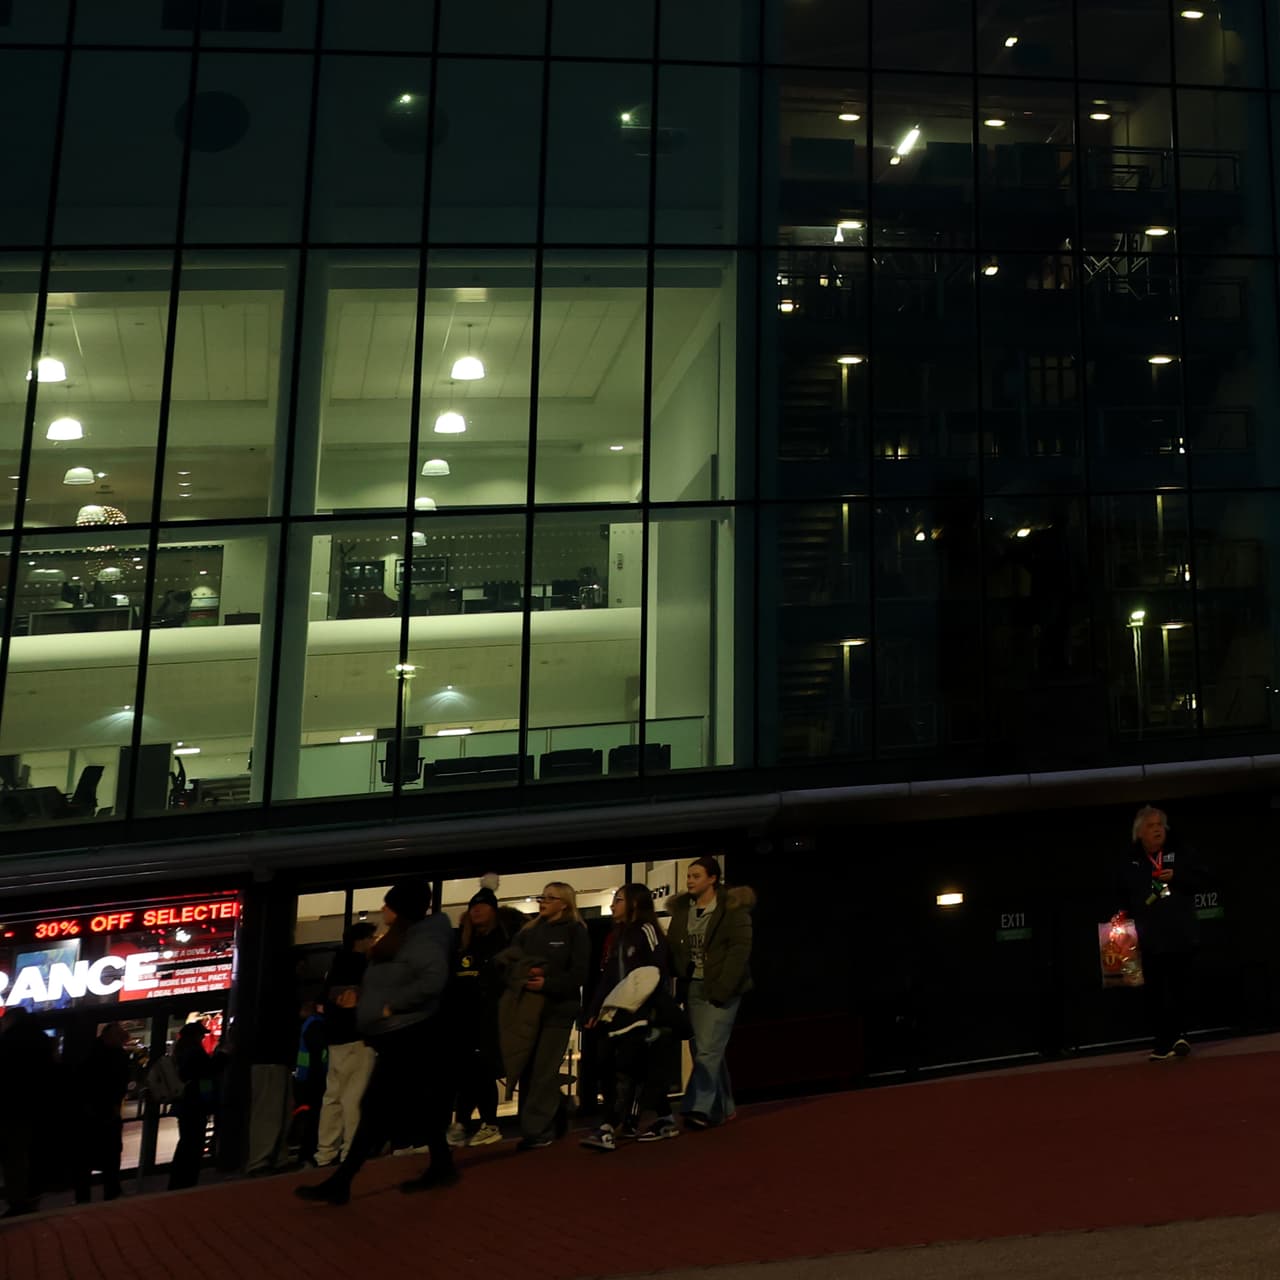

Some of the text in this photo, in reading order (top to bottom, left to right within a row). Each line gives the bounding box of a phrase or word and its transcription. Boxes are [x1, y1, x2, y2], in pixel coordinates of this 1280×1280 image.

[35, 902, 239, 939] 30% OFF SELECTE
[0, 952, 160, 1007] ANCE
